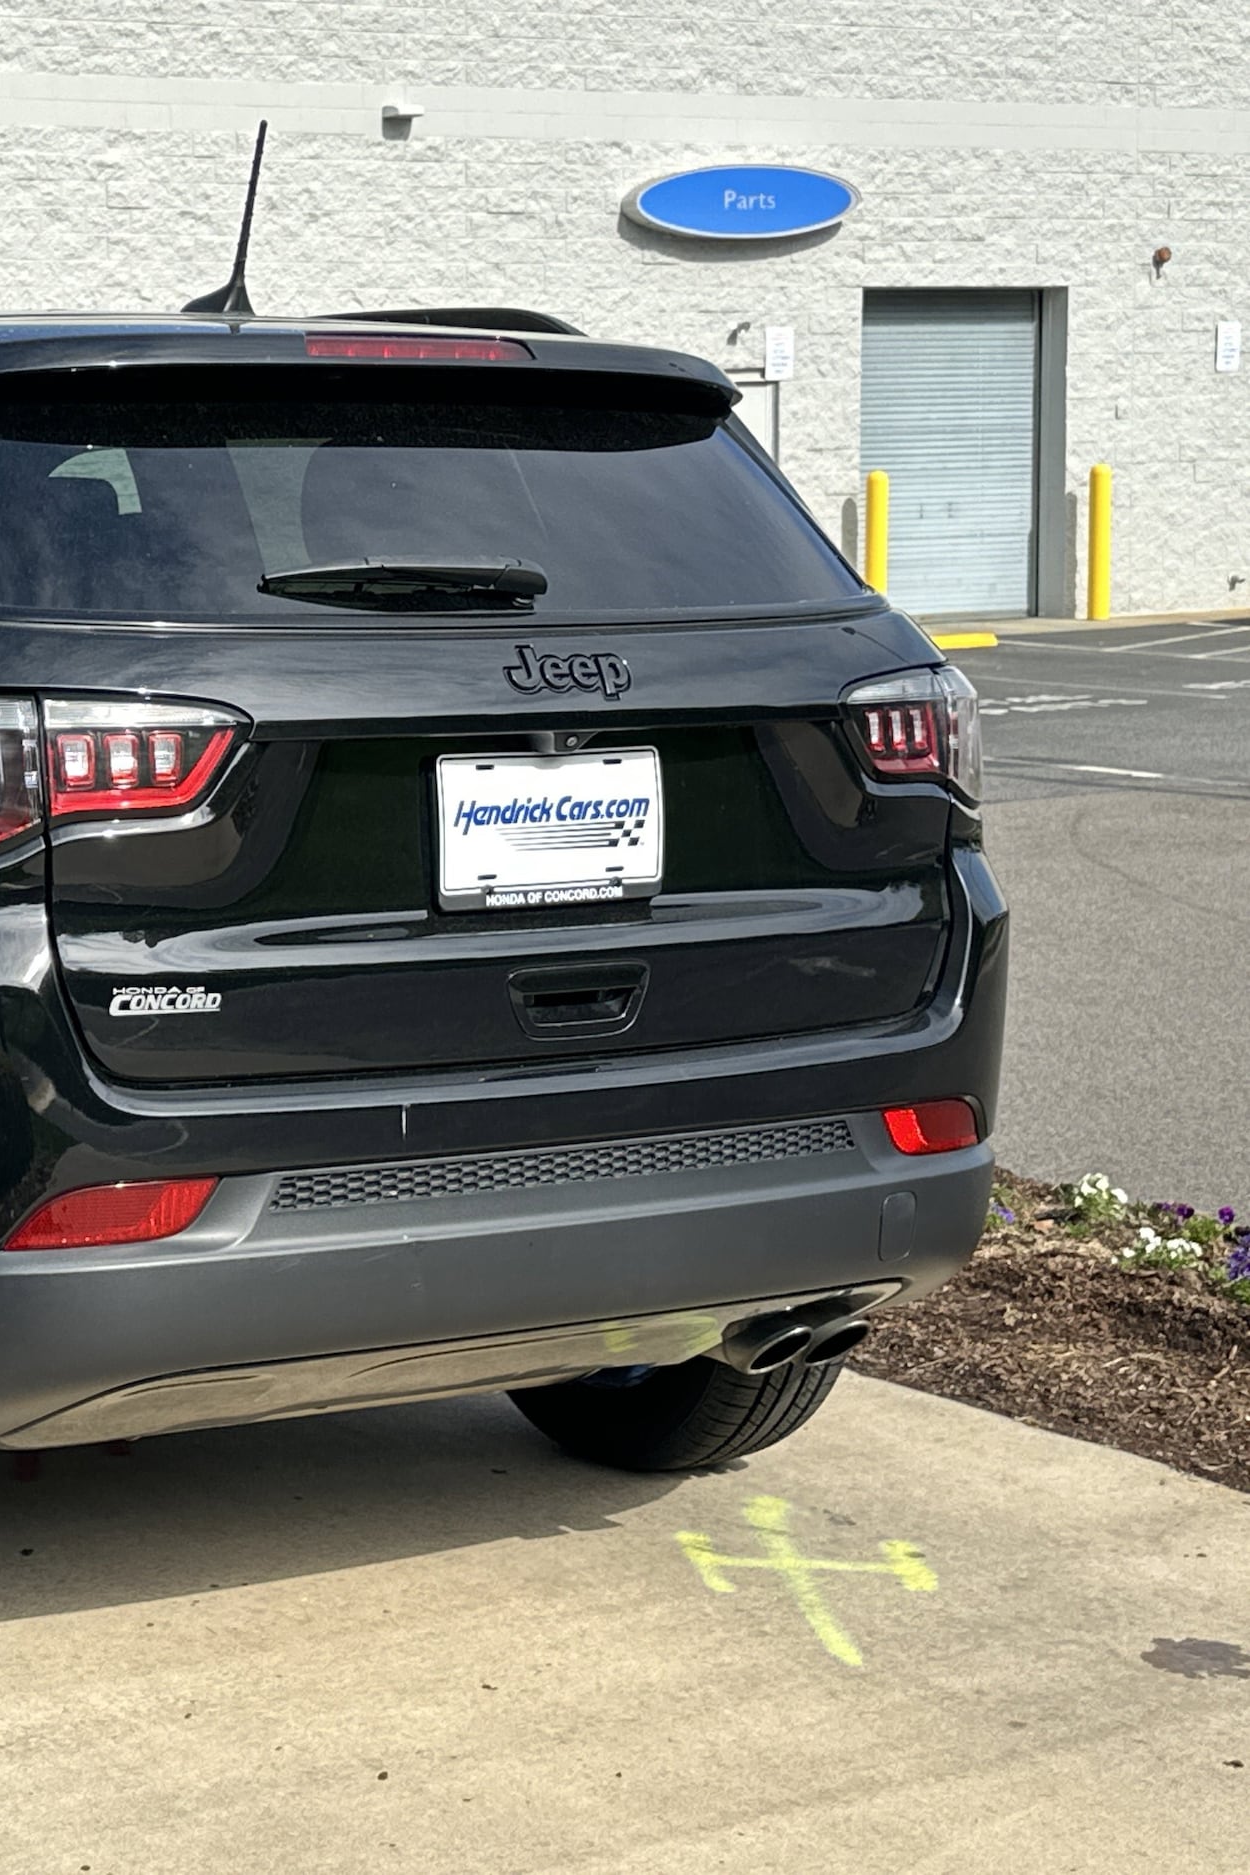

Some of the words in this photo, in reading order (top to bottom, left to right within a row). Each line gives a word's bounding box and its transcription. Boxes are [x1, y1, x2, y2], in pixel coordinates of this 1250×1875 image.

[724, 189, 776, 209] Parts
[503, 644, 632, 701] Jeep
[486, 892, 525, 907] HONDA
[527, 891, 543, 904] OF
[544, 885, 623, 902] CONCORD.COM
[112, 986, 182, 995] HONDA
[186, 986, 205, 994] OF
[109, 992, 221, 1016] CONCORD
